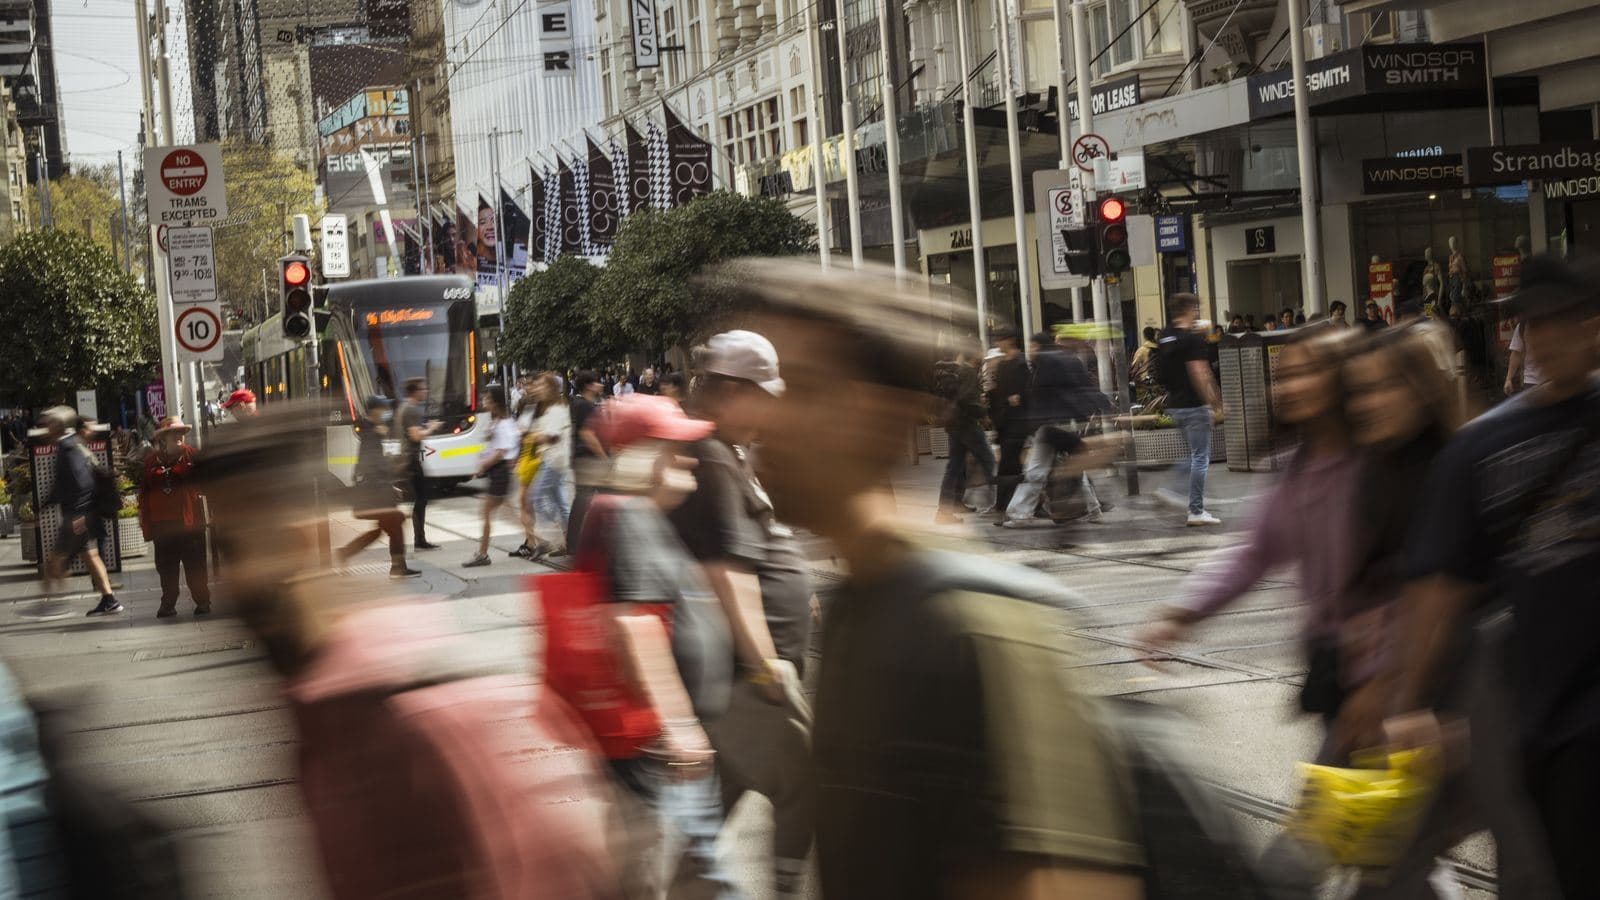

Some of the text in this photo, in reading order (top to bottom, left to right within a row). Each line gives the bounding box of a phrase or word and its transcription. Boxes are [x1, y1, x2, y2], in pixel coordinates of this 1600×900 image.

[1368, 50, 1475, 69] WINDSOR
[1259, 64, 1350, 103] WINDSRSMITH
[1385, 67, 1459, 84] SMITH
[1107, 83, 1136, 111] LEASE
[176, 154, 191, 166] NO
[169, 178, 202, 189] ENTRY
[1544, 177, 1600, 199] WINDSO
[169, 196, 208, 208] TRAMS
[161, 208, 217, 221] EXCEPTED
[186, 320, 210, 341] 10
